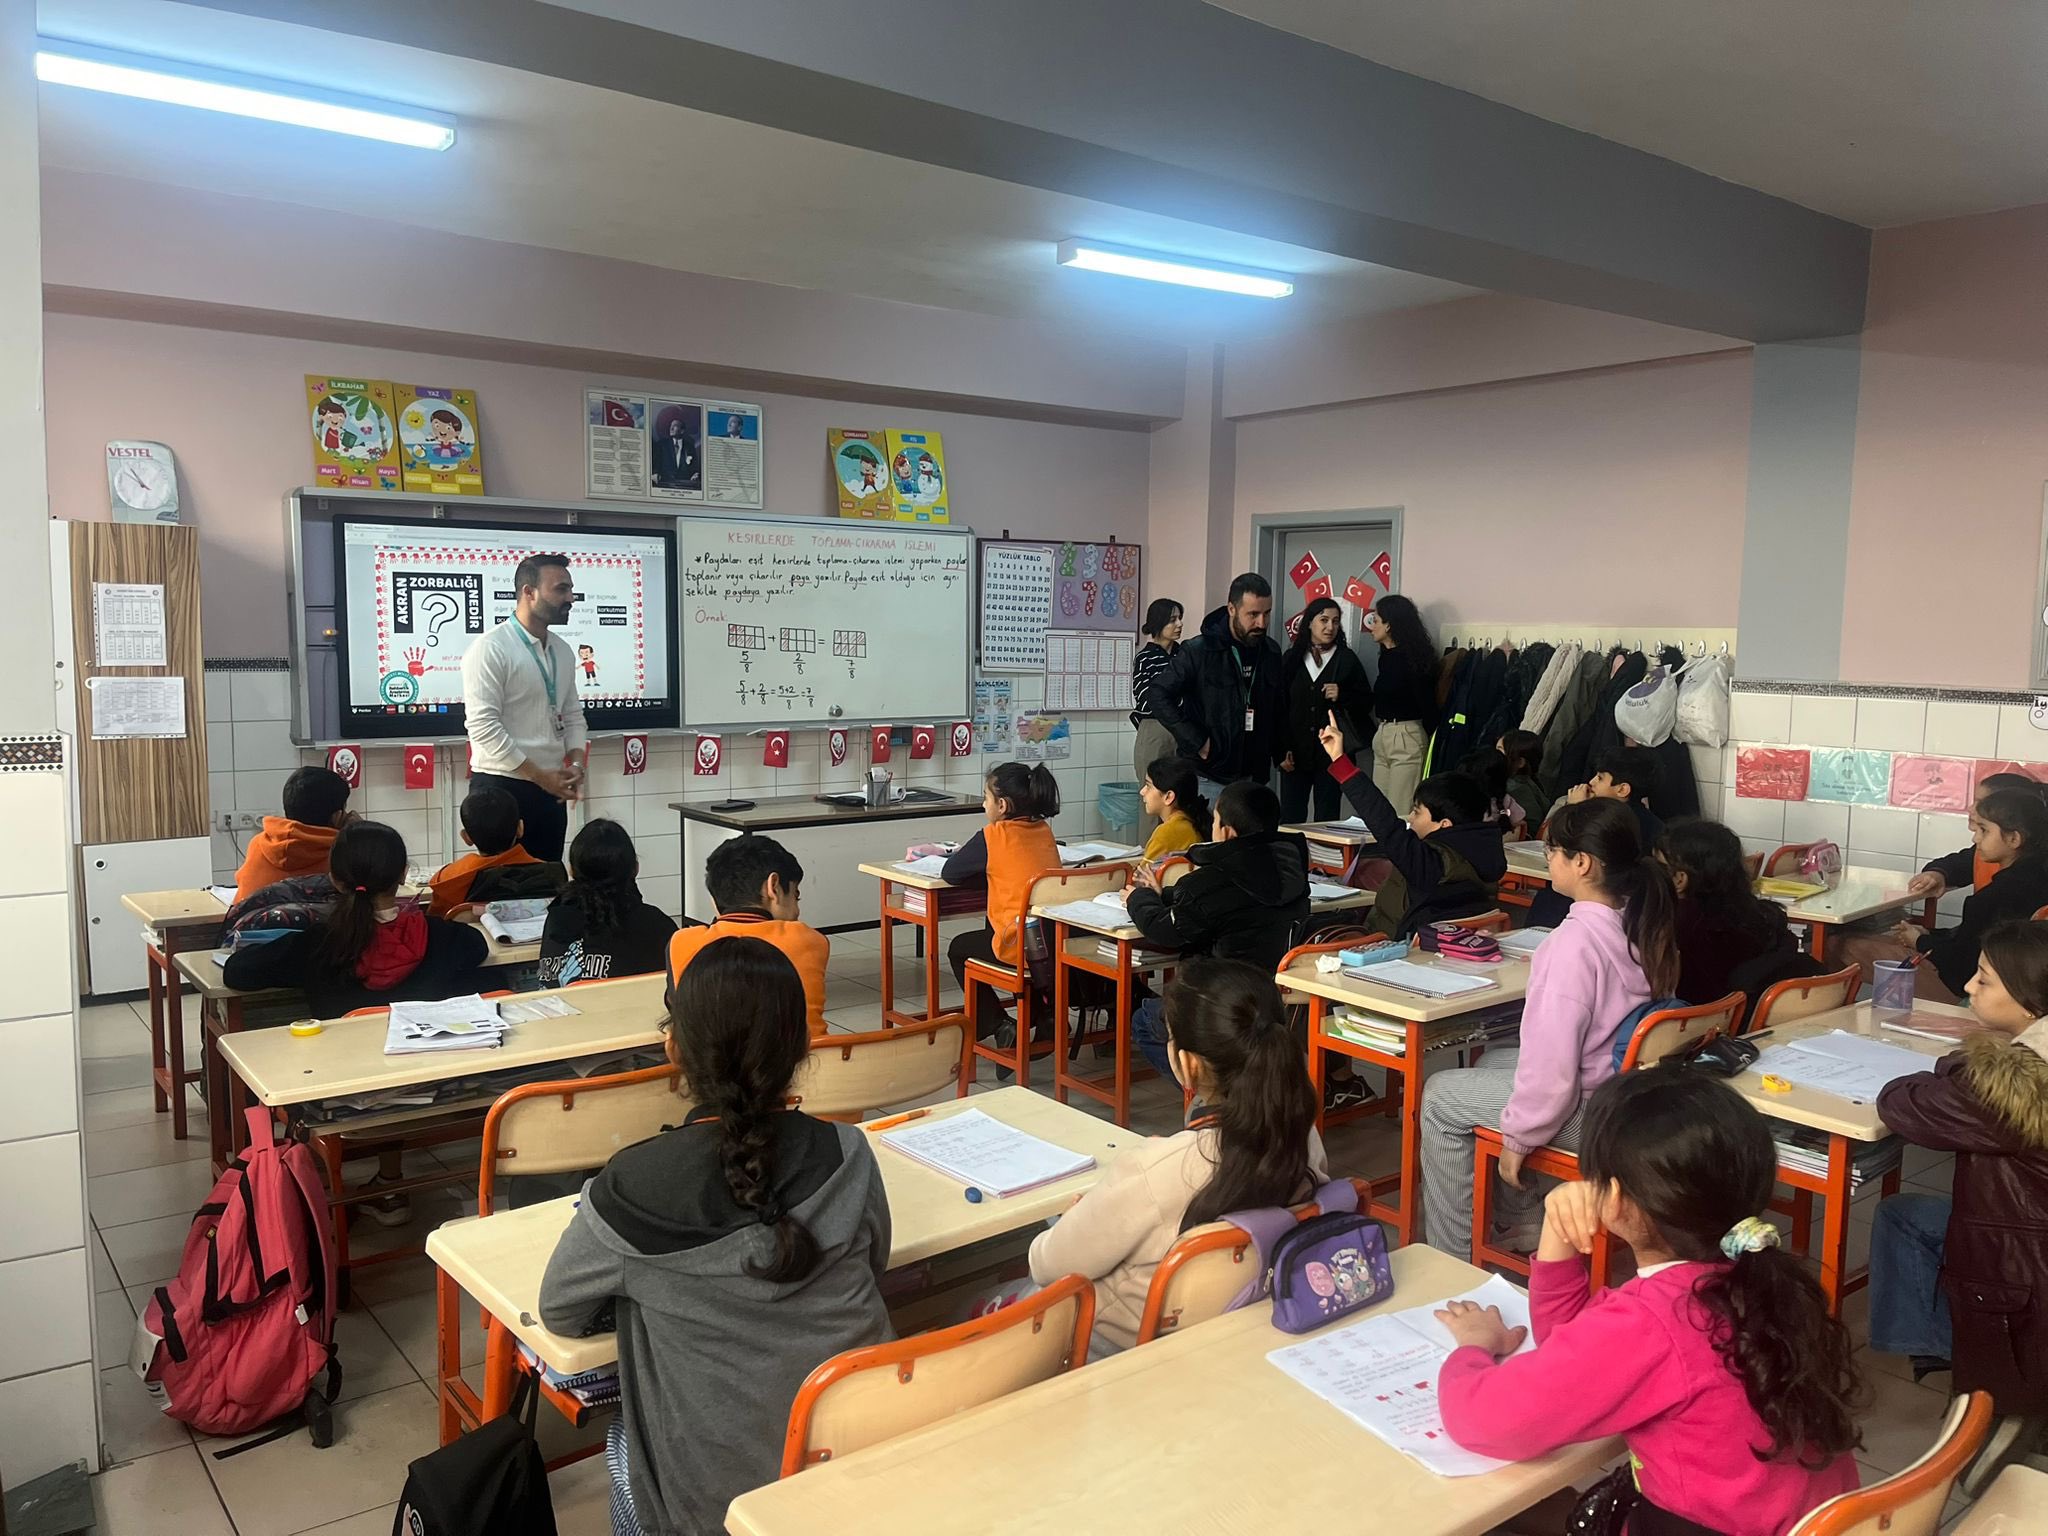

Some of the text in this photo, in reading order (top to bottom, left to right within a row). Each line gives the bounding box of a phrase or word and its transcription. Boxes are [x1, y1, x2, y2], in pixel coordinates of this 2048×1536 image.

[330, 381, 365, 390] İLKBAHAR
[108, 447, 153, 457] VESTEL
[320, 467, 337, 475] Mart
[998, 552, 1042, 562] YÜZLÜK TABLO
[1059, 541, 1136, 581] 2 3 4 5
[409, 575, 478, 589] ZORBALIĞI
[396, 577, 409, 625] AKRAN
[1060, 581, 1136, 619] 6 7 8 9
[468, 589, 482, 629] NEDİR
